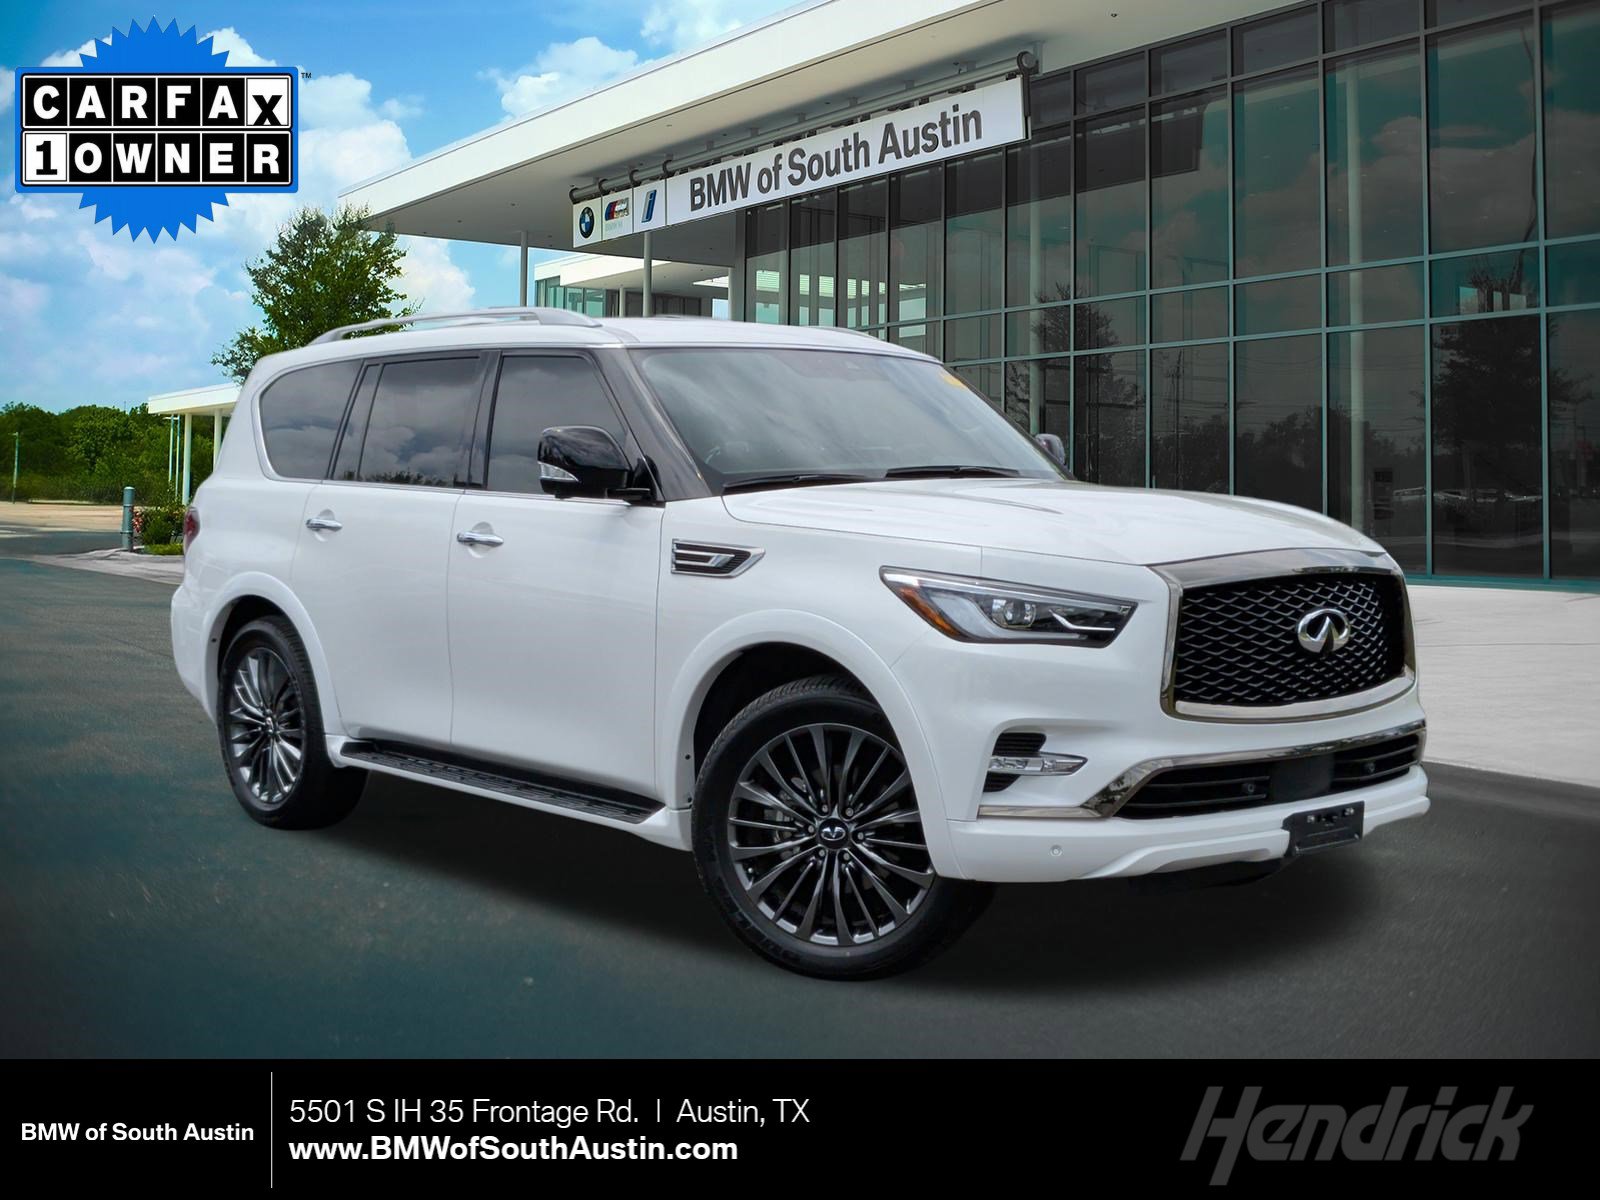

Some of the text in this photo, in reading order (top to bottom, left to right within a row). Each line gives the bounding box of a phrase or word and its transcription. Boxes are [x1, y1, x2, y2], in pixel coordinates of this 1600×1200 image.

[689, 162, 752, 212] BMW
[757, 153, 783, 195] of
[787, 132, 871, 187] South
[878, 104, 983, 165] Austin
